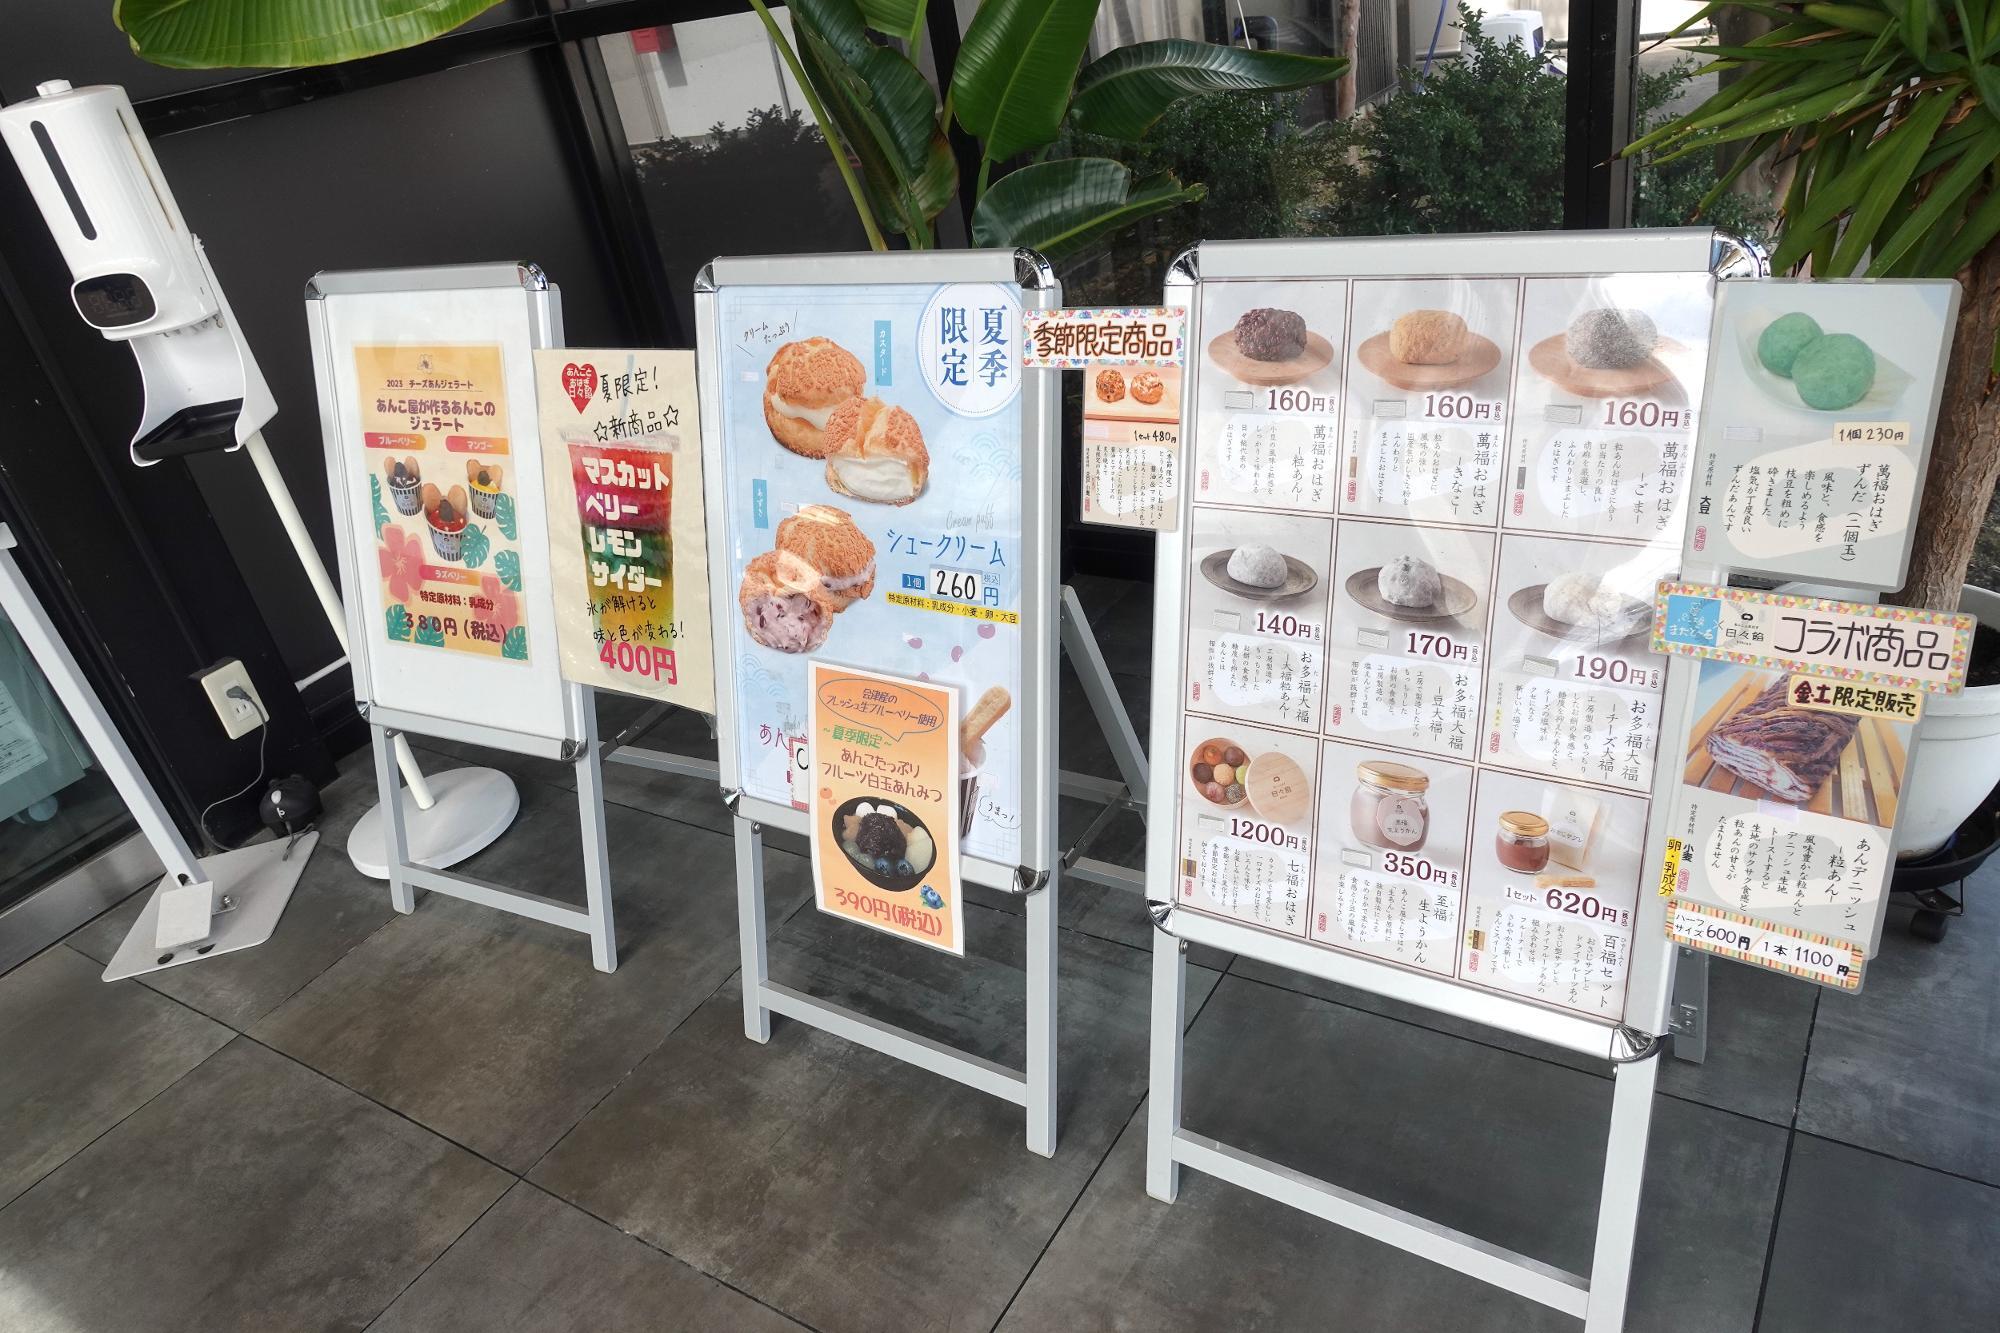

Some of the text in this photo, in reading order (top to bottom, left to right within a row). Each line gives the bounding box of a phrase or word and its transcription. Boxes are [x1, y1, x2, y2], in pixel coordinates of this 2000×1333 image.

[879, 330, 888, 376] カスタード
[940, 306, 969, 387] 限定
[977, 305, 1009, 388] 夏季
[1033, 321, 1173, 358] 季節限定商品
[387, 380, 474, 389] 2023 チーズあんジェラート
[566, 368, 592, 377] あんこと
[569, 377, 591, 387] おはぎ
[376, 398, 496, 416] あんこ屋が作るあんこの
[1268, 389, 1325, 413] 160円
[1425, 394, 1490, 419] 160円
[1604, 401, 1679, 428] 160円
[378, 436, 417, 446] ブルーベリー
[410, 416, 464, 432] ジェラート
[1152, 430, 1177, 444] 480円
[1839, 428, 1904, 442] 1個 230円
[466, 441, 494, 450] マンゴー
[1311, 424, 1326, 502] 萬福おはぎ
[1392, 432, 1401, 473] ふんわりと
[1551, 440, 1562, 482] おはぎです
[582, 456, 670, 491] マスカット
[1472, 432, 1491, 516] 萬福おはぎ
[1561, 440, 1576, 519] ふんわりとまぶした
[1593, 443, 1607, 503] 口当たりの良い
[1655, 442, 1679, 531] 萬福おはぎ
[1762, 466, 1779, 517] 砕きました
[1851, 463, 1871, 503] ずんだ
[586, 493, 639, 521] ベリー
[1698, 495, 1712, 515] 大豆
[1723, 464, 1744, 532] ずんだあんです
[1741, 465, 1761, 533] 塩気が丁度良い
[1799, 469, 1816, 531] 楽しめるよう
[1867, 463, 1891, 533] 萬福おはぎ
[946, 510, 973, 531] Cream
[589, 527, 642, 558] レモン
[887, 529, 1006, 567] シュークリーム
[435, 569, 468, 580] ラズベリー
[592, 561, 662, 593] サイダー
[906, 570, 999, 607] 1個 260 税込 円
[586, 594, 657, 616] 氷が解けると
[1256, 612, 1311, 638] 140円
[1725, 628, 1764, 642] 日々餡
[1774, 616, 1950, 671] コラボ商品
[600, 639, 678, 686] 400円
[1219, 641, 1227, 671] あんこは
[1407, 632, 1468, 661] 170円
[1296, 652, 1312, 724] お多福大福
[1375, 664, 1385, 703] 工房製造の
[1574, 655, 1647, 686] 190円
[827, 695, 938, 728] フレッシュ生ブルーベリー使用
[862, 687, 898, 704] 会津産の
[1448, 673, 1468, 751] お多福大福
[1527, 686, 1537, 722] クセになる
[1620, 699, 1647, 782] お多福大福
[840, 748, 920, 778] あんこたっぷり
[822, 762, 943, 803] フルーツ白玉あんみつ
[1230, 818, 1299, 850] 1200円
[1681, 843, 1695, 863] 小麦
[1711, 816, 1727, 869] たまりません
[1726, 819, 1745, 881] 粒あんの甘さが
[1384, 852, 1447, 884] 350円
[1659, 839, 1682, 895] 卵・乳成分
[1739, 823, 1761, 912] 生地のサクサク食感と
[1761, 827, 1778, 890] トーストすると
[1777, 831, 1798, 894] デニッシュ生地
[1793, 834, 1816, 917] 風味豊かな粒あんと
[1285, 859, 1300, 927] 七福おはぎ
[1843, 838, 1872, 932] あんデニッシュ
[1433, 894, 1449, 922] 至福
[1505, 887, 1617, 923] 1セット 620円
[1414, 898, 1430, 964] 生ようかん
[1502, 913, 1514, 970] さわやかな新しい
[1674, 923, 1704, 938] サイズ
[1675, 913, 1850, 977] ハーフ 600円 1本 1100円
[1567, 935, 1583, 1004] ドライフルーツあん
[1599, 933, 1620, 1008] 百福セット
